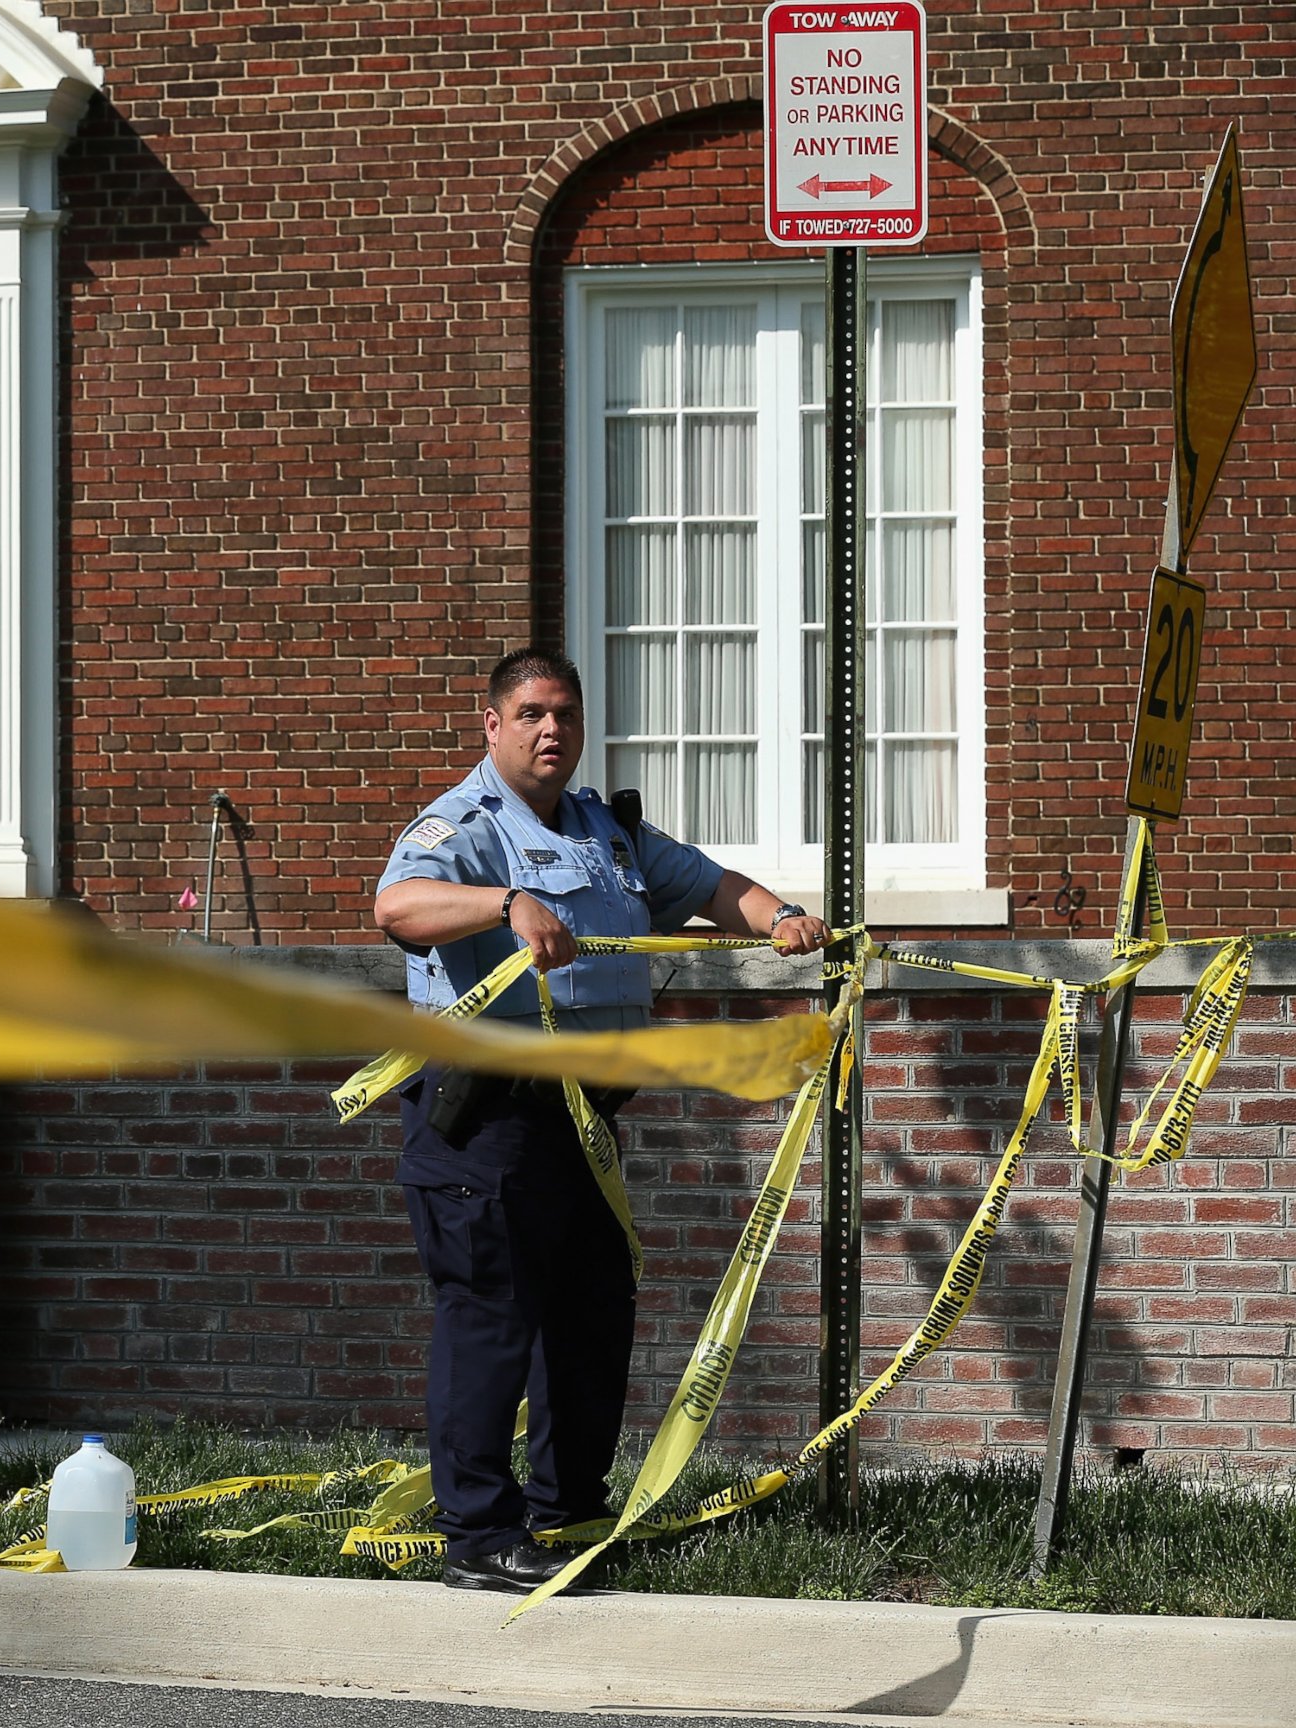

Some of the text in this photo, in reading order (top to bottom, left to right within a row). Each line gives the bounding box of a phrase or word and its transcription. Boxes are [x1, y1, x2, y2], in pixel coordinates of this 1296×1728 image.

[789, 11, 899, 28] TOW AWAY
[827, 48, 862, 68] NO
[790, 75, 901, 96] STANDING
[787, 103, 904, 124] OR PARKING
[793, 136, 899, 157] ANYTIME
[779, 218, 913, 235] IF TOWED 727-5000
[1146, 604, 1195, 723] 20
[1059, 1023, 1078, 1075] CROSS
[890, 1339, 933, 1385] CROSS
[921, 1291, 965, 1342] CRIME
[948, 1229, 993, 1299] SOLVERS
[354, 1541, 402, 1563] POLICE
[405, 1541, 437, 1559] LINE
